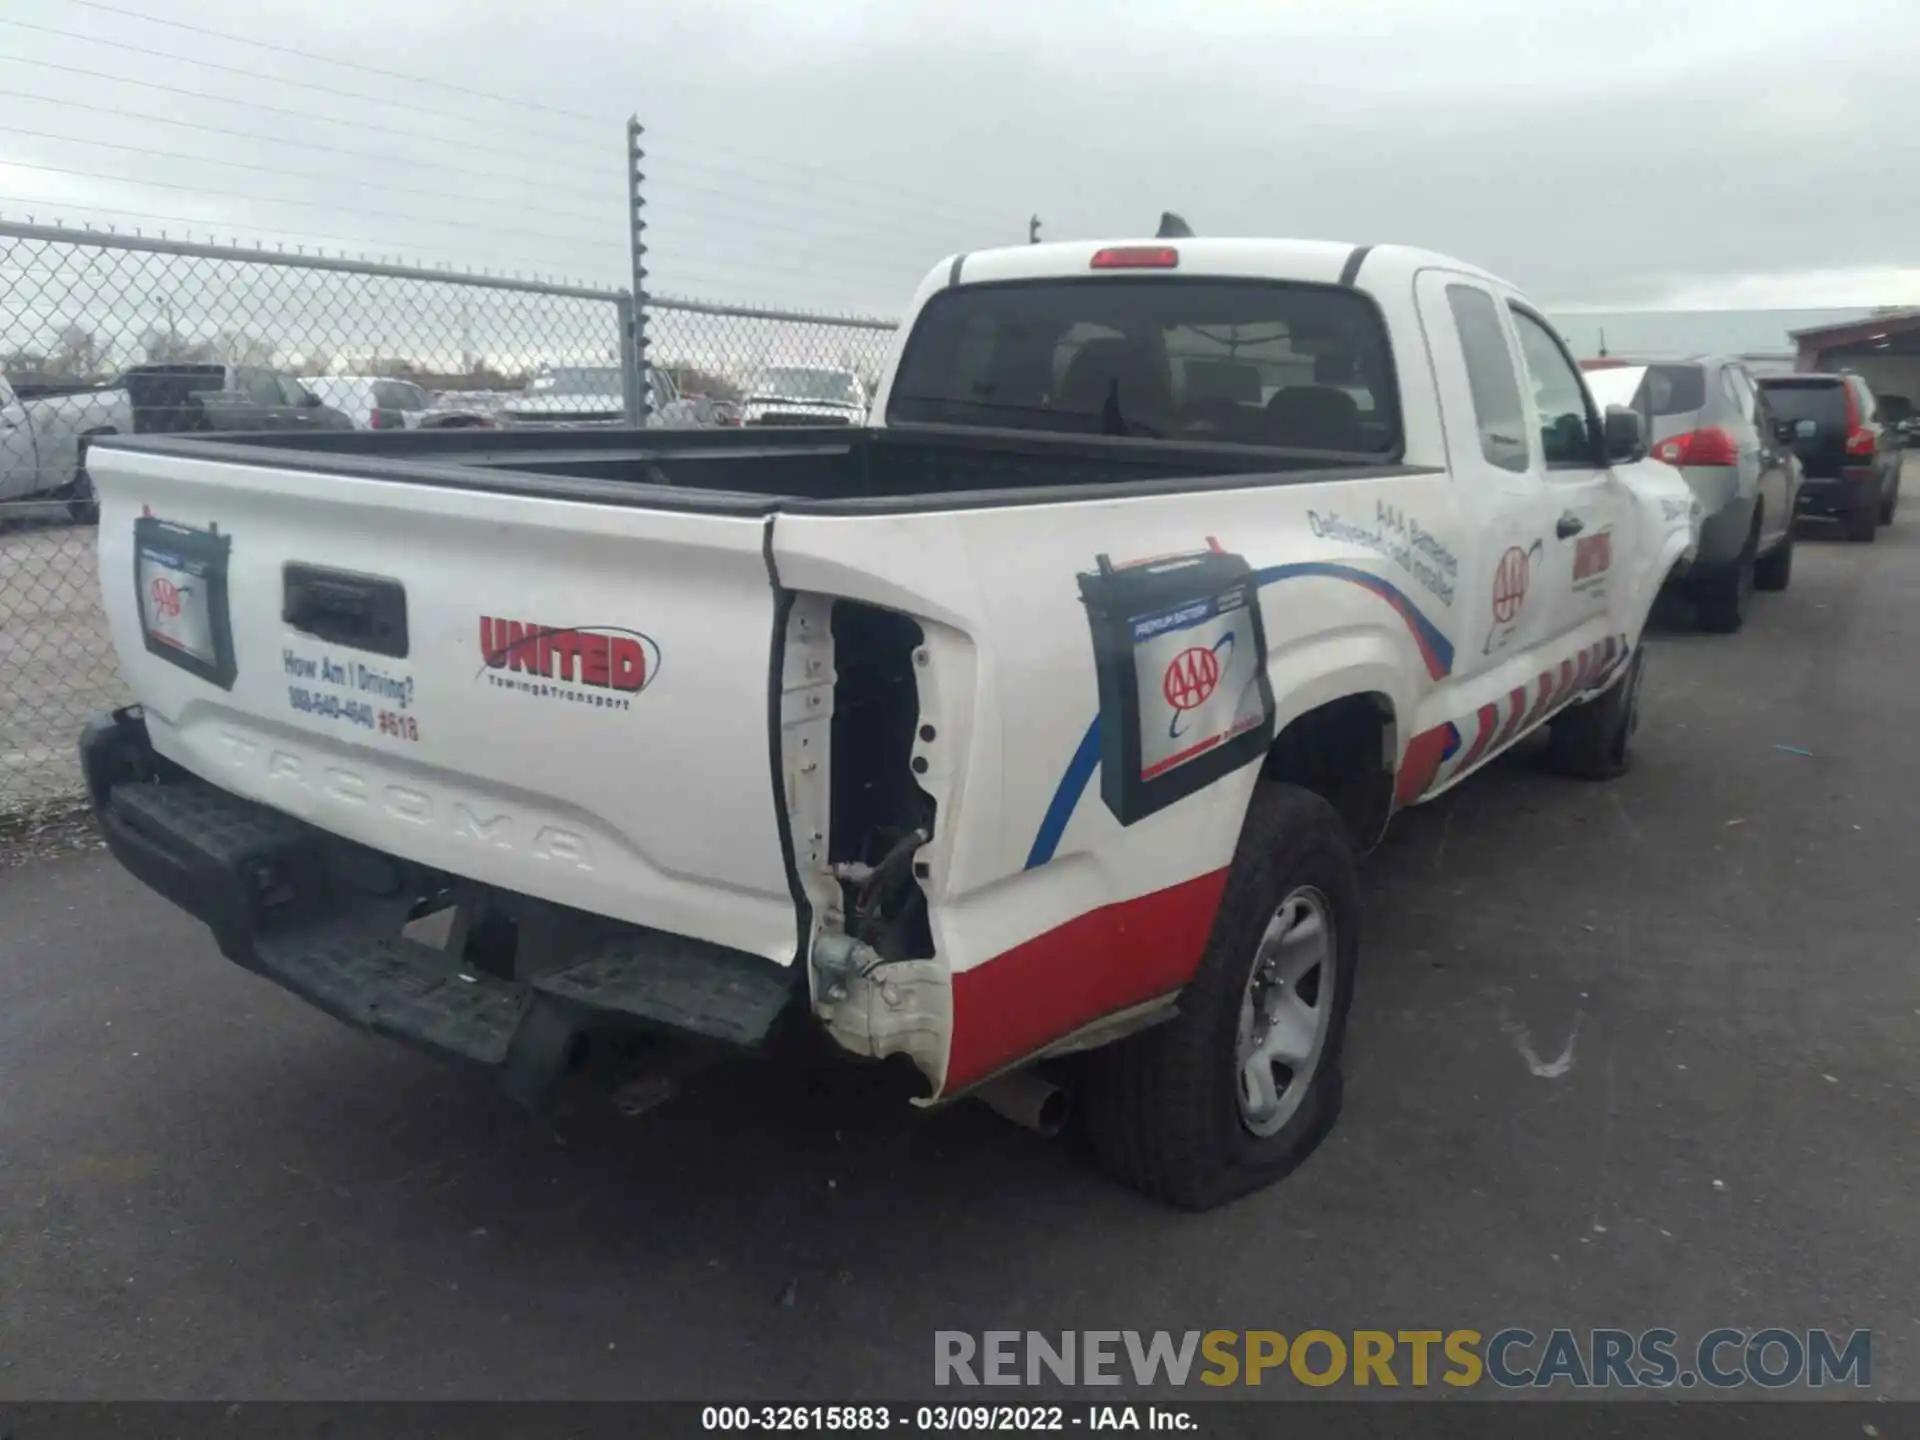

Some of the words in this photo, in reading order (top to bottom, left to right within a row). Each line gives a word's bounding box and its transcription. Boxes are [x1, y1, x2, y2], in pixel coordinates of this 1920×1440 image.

[283, 648, 317, 679] How
[322, 655, 346, 686] Am
[358, 663, 414, 709] Driving?
[480, 615, 646, 692] UNITED
[1166, 650, 1217, 707] AAA
[219, 727, 595, 872] TACOMA
